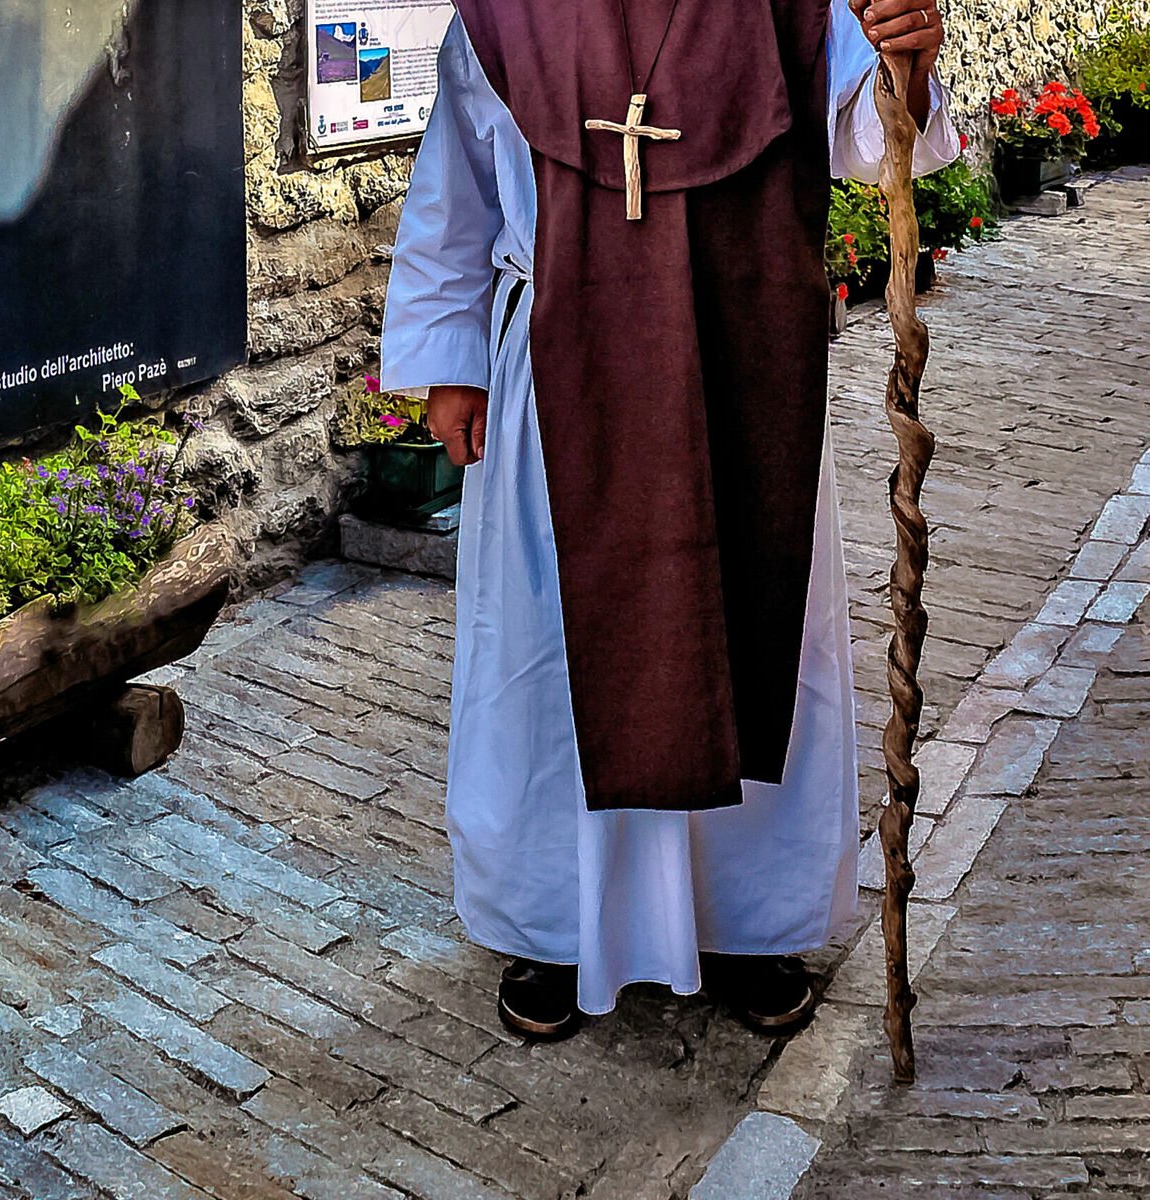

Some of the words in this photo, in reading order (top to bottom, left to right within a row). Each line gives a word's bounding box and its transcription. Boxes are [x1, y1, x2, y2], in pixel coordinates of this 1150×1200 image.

[40, 341, 135, 380] dell'architetto:
[102, 370, 136, 392] Piero
[138, 358, 167, 381] Pazè
